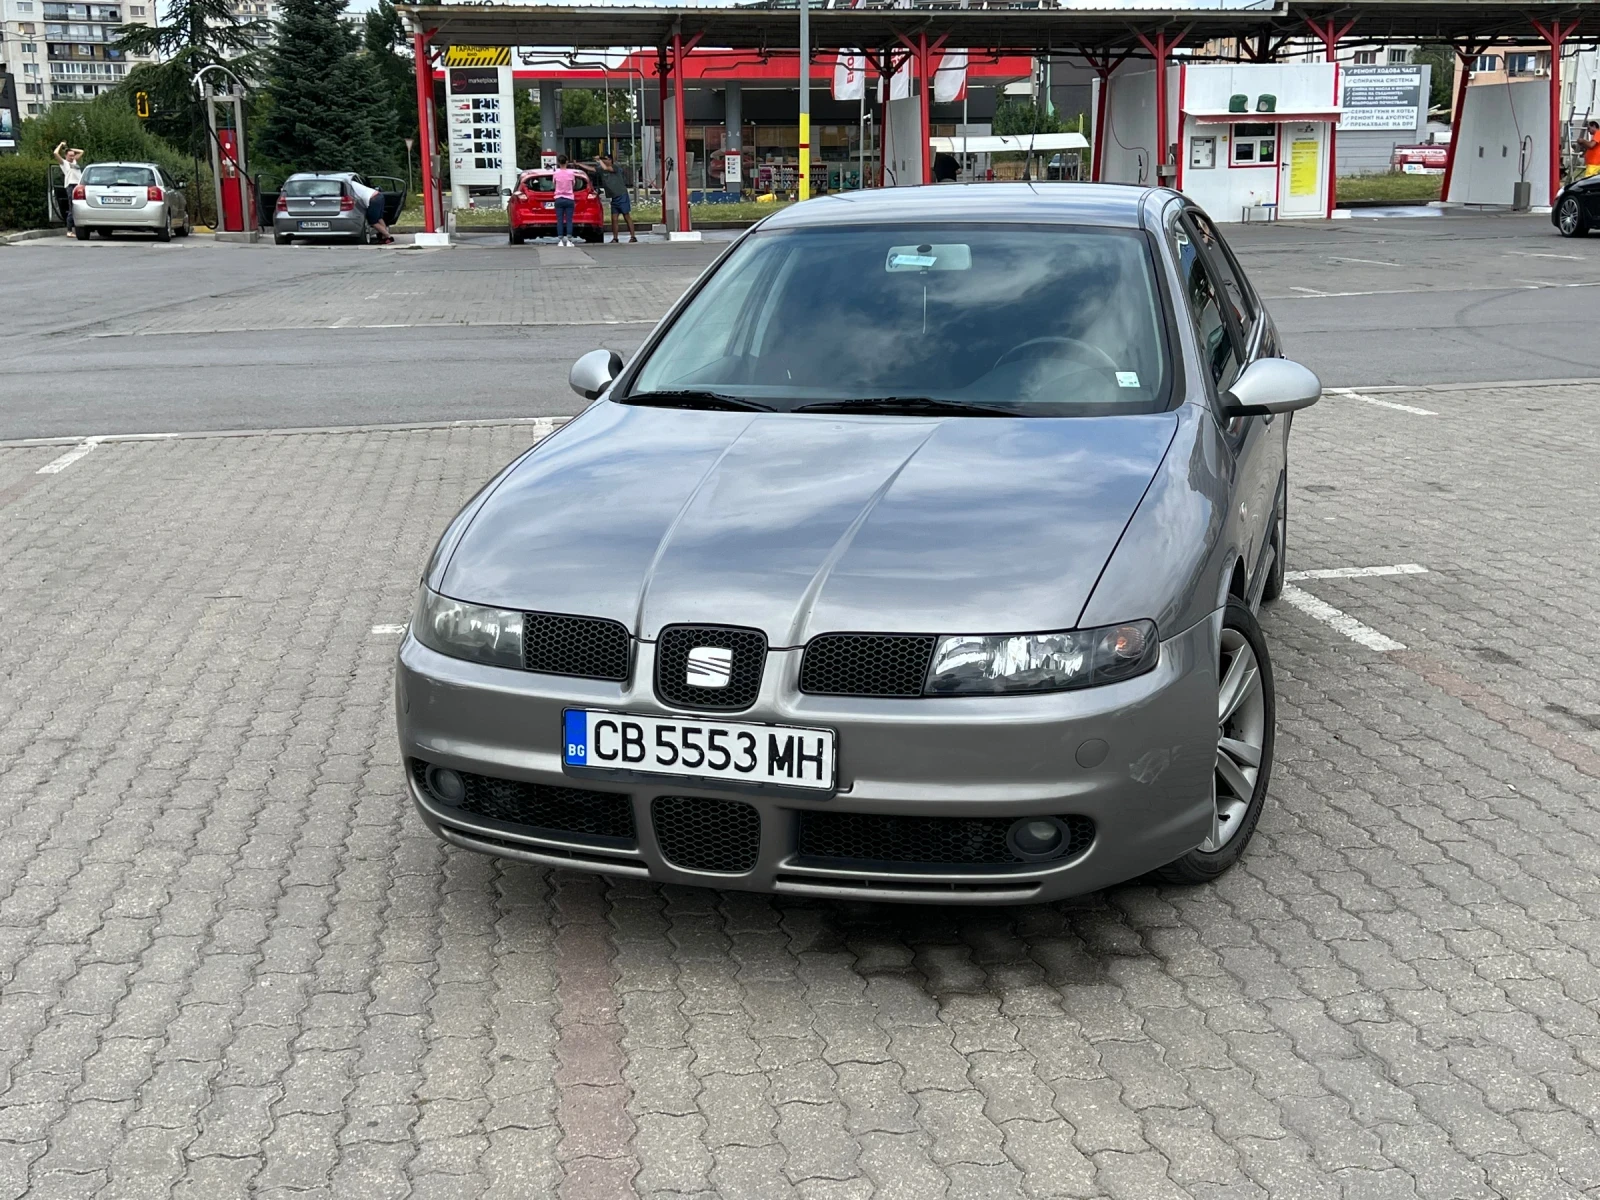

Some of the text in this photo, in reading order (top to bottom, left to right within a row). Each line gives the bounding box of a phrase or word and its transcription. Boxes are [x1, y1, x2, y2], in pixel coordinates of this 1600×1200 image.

[468, 77, 497, 85] marketplace
[568, 743, 585, 757] BG
[594, 719, 825, 781] CB 5553 MH
